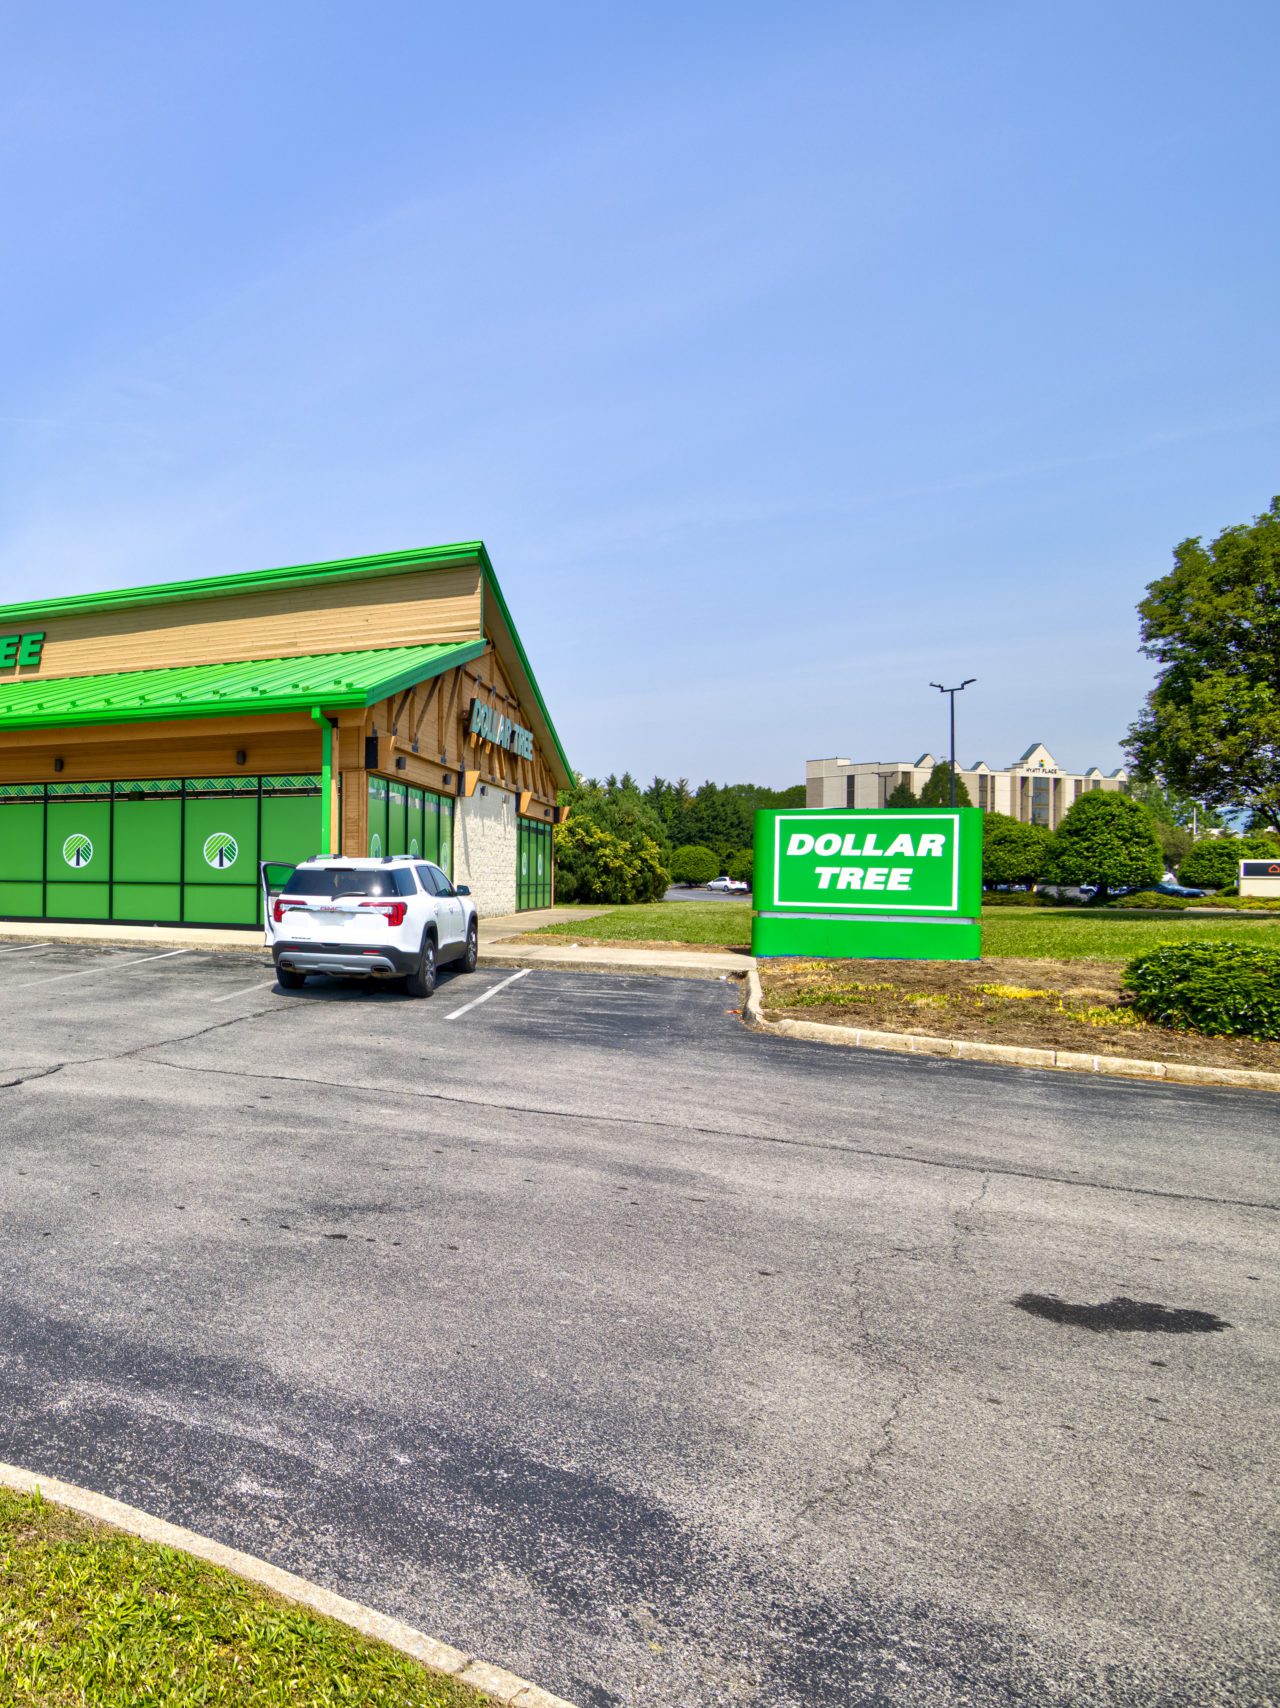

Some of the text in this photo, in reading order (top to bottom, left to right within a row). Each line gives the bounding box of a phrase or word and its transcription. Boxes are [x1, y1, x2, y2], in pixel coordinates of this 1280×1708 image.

[471, 698, 534, 761] DOLLAR TREE
[786, 833, 946, 856] DOLLAR
[814, 867, 913, 891] TREE
